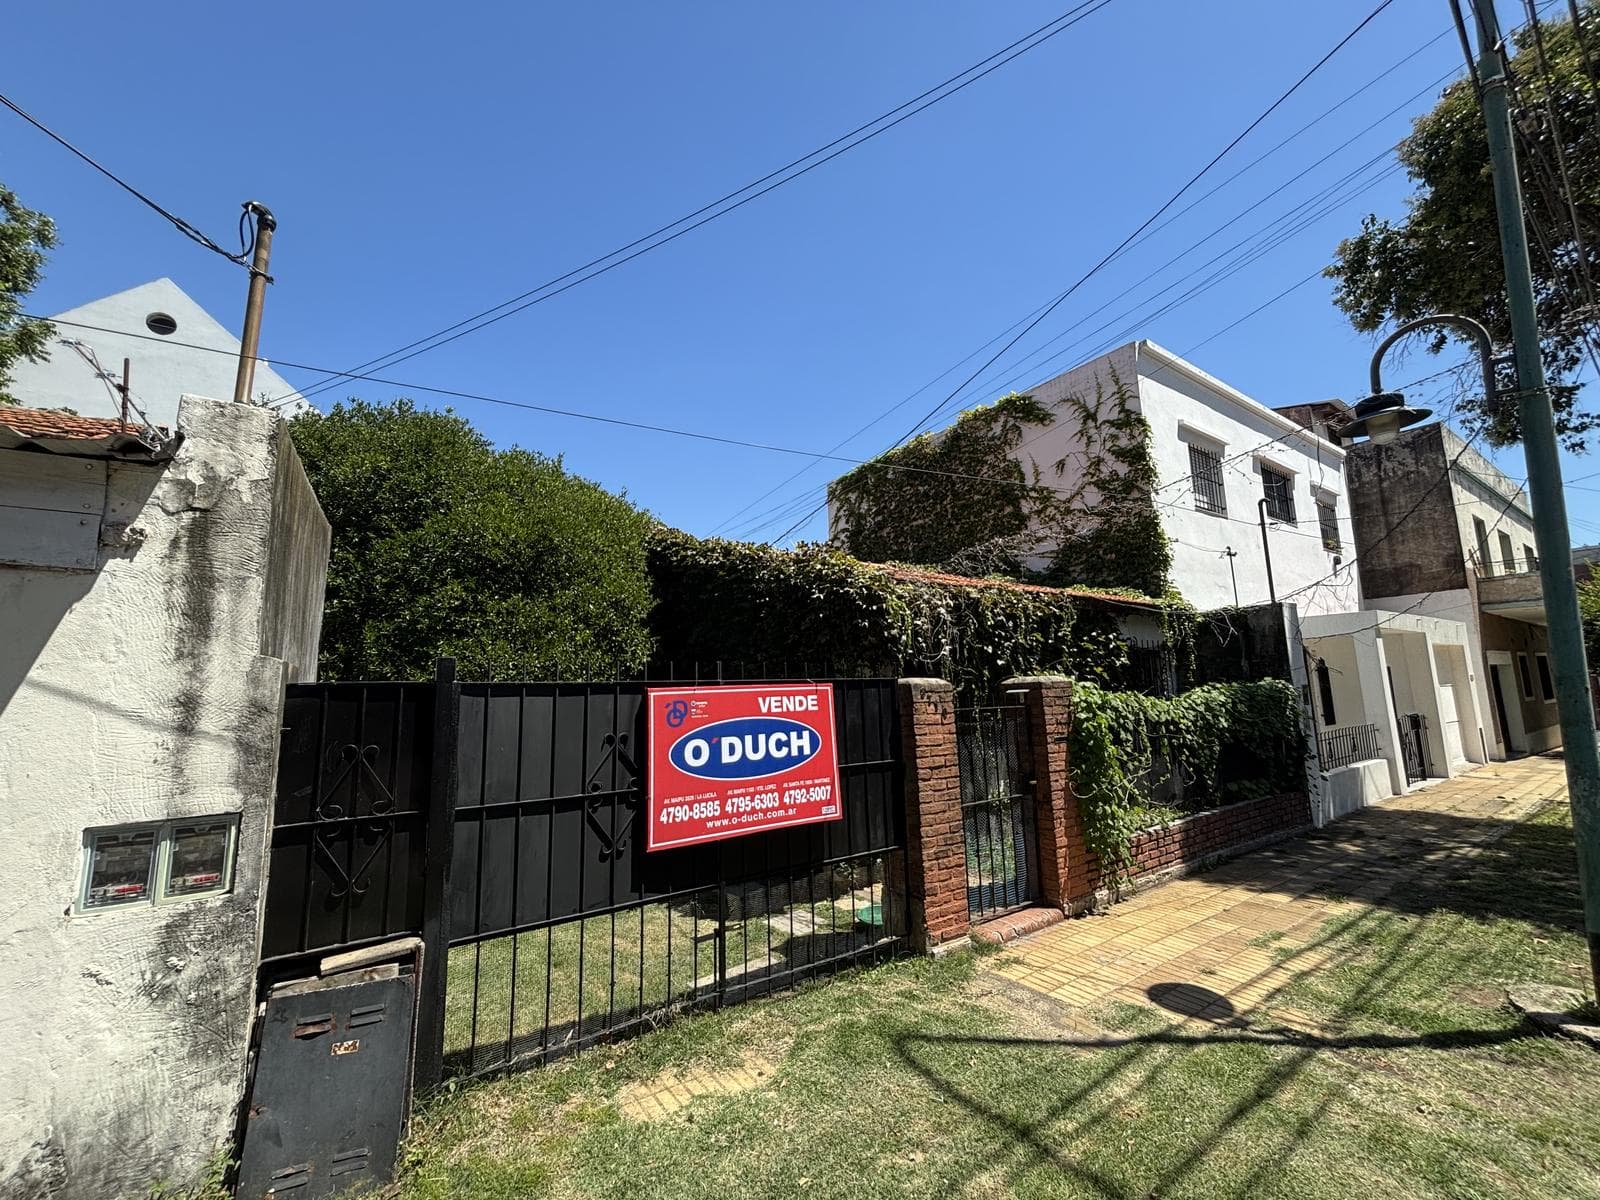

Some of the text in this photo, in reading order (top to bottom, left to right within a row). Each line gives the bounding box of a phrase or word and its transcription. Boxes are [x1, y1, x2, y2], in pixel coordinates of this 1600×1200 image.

[758, 695, 818, 713] VENDE
[660, 786, 831, 824] 4790-8585 4795-6303 4792-5007
[706, 807, 798, 829] www.o-duch.com.ar
